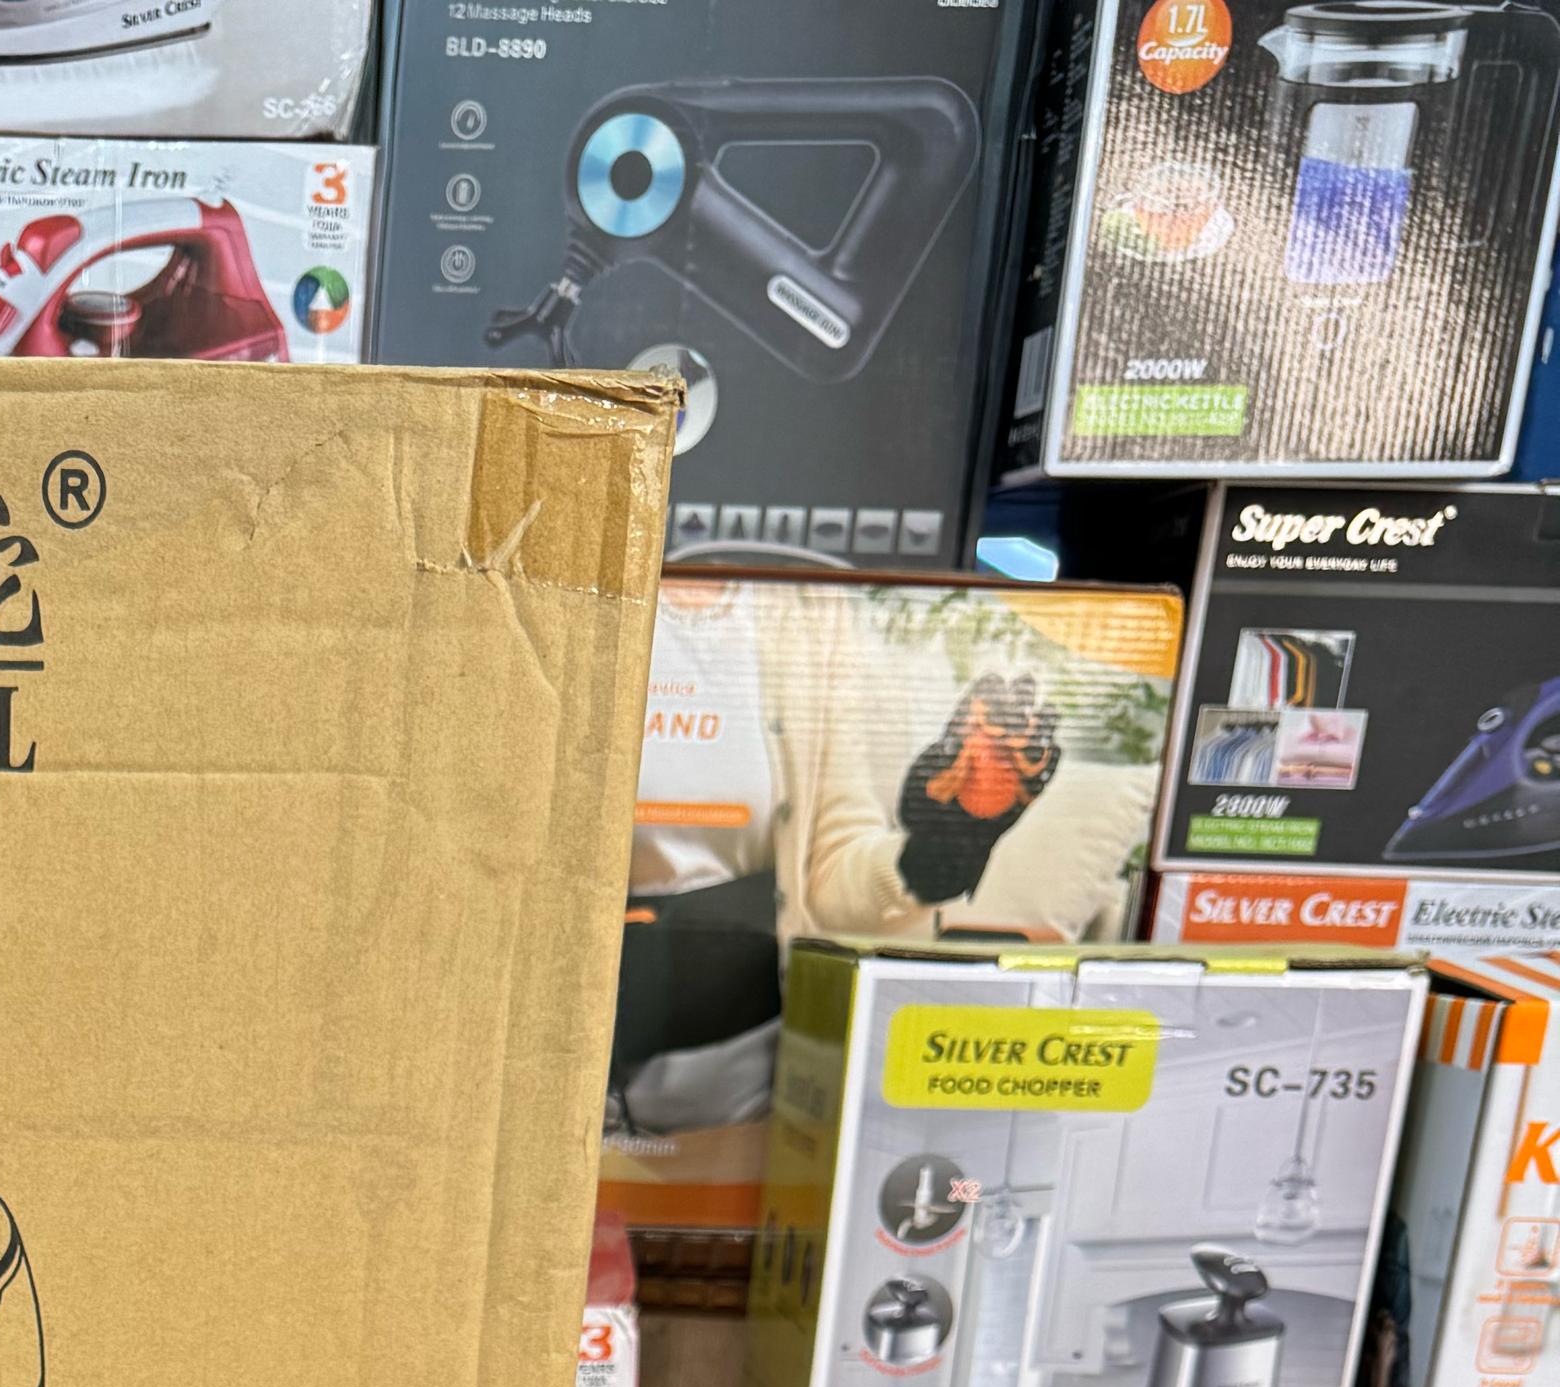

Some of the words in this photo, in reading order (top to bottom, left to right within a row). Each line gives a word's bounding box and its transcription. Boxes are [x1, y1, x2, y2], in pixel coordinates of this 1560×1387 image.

[449, 3, 466, 19] 12
[467, 3, 538, 24] Massage
[541, 6, 592, 23] Heads
[1169, 5, 1208, 33] 1.7L
[1140, 42, 1228, 64] Capacity
[32, 158, 116, 187] Steam
[127, 161, 187, 190] Iron
[312, 163, 346, 205] 3
[1124, 358, 1208, 380] 2000W
[1232, 504, 1345, 550] Super
[1346, 508, 1444, 546] Crest
[1190, 890, 1295, 924] SILVER
[1299, 890, 1397, 928] CREST
[1520, 902, 1560, 929] Ste
[923, 1032, 1026, 1067] SILVER
[1036, 1034, 1136, 1068] CREST
[928, 1075, 992, 1096] FOOD
[996, 1076, 1102, 1099] CHOPPER
[1225, 1066, 1377, 1101] SC-735
